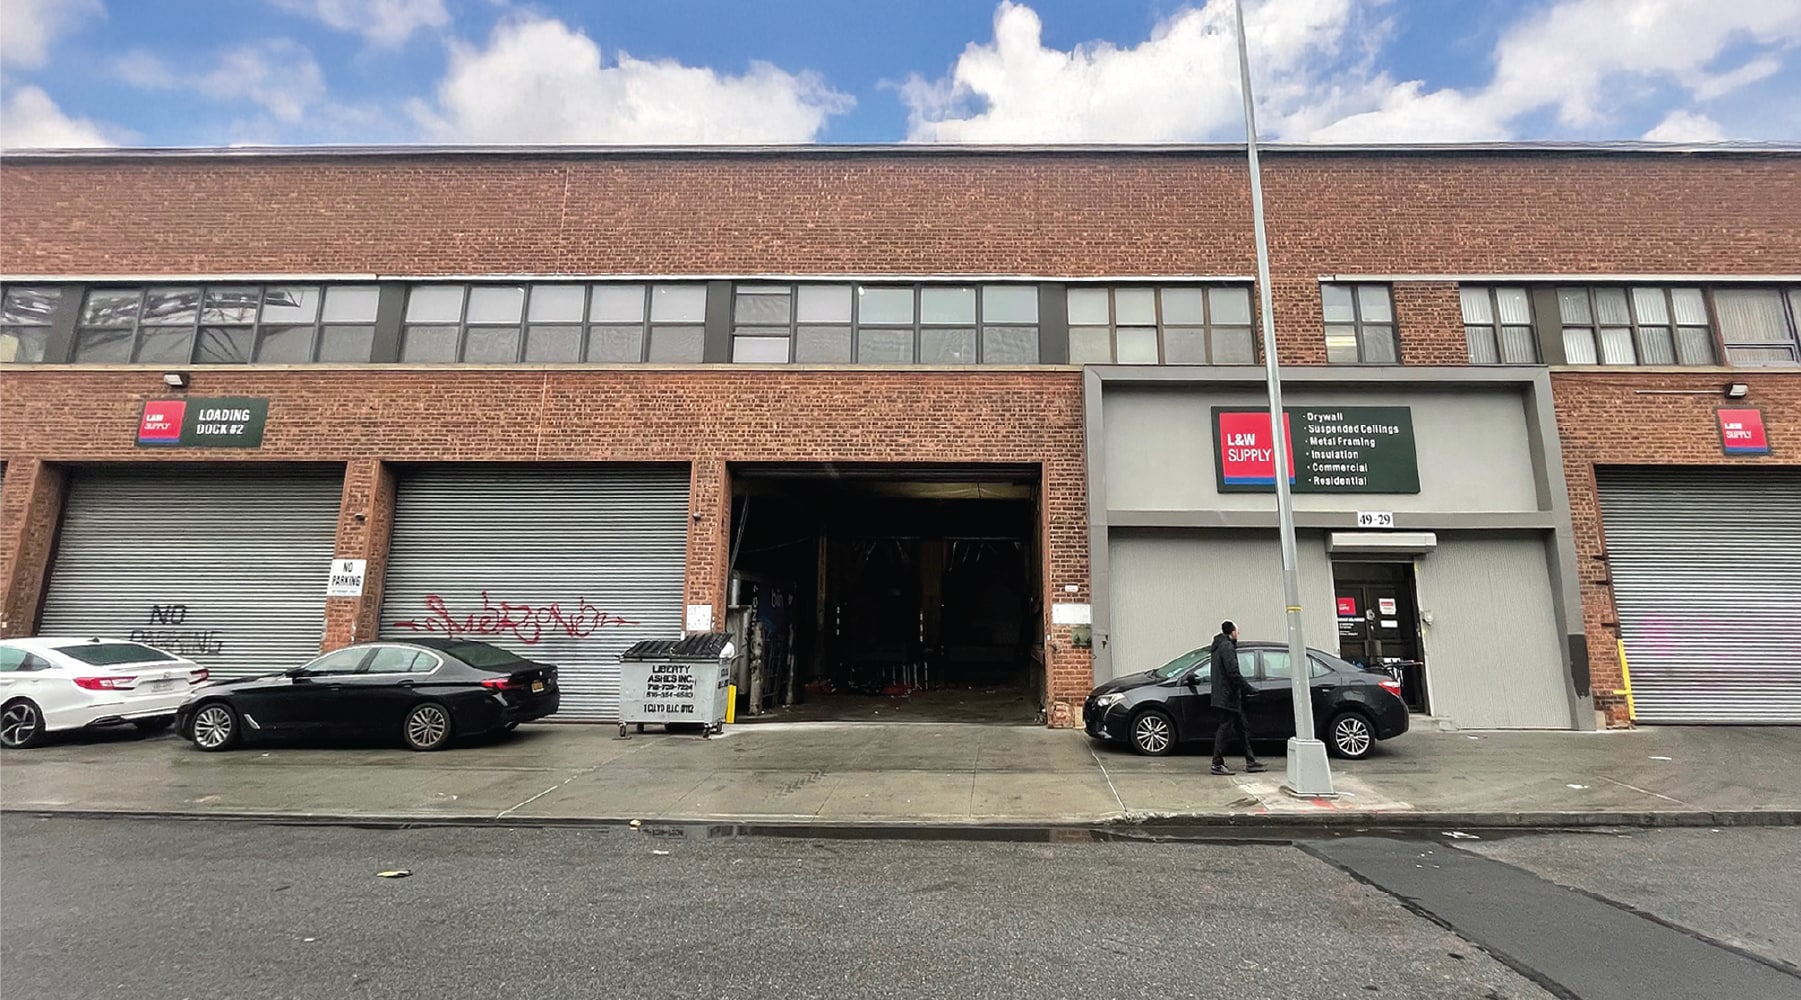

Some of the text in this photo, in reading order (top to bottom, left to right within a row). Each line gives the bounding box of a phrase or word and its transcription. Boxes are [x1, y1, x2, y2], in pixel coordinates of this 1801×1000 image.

[198, 409, 250, 421] LOADING
[1307, 412, 1343, 423] Drywall
[196, 424, 244, 435] DOCK #2
[1308, 424, 1399, 435] Suspended Ceilings
[1725, 430, 1752, 439] SUPPLY
[1227, 433, 1255, 446] L&W
[1310, 437, 1376, 448] Metal Framing
[1228, 448, 1272, 462] SUPPLY
[1311, 449, 1359, 460] Insulation
[1312, 462, 1368, 473] Commercial
[1313, 475, 1367, 486] Residential
[343, 561, 354, 573] NO
[331, 575, 361, 587] PARKING
[149, 604, 187, 625] NO
[652, 665, 691, 674] LIBERTY
[647, 675, 678, 683] ASHES
